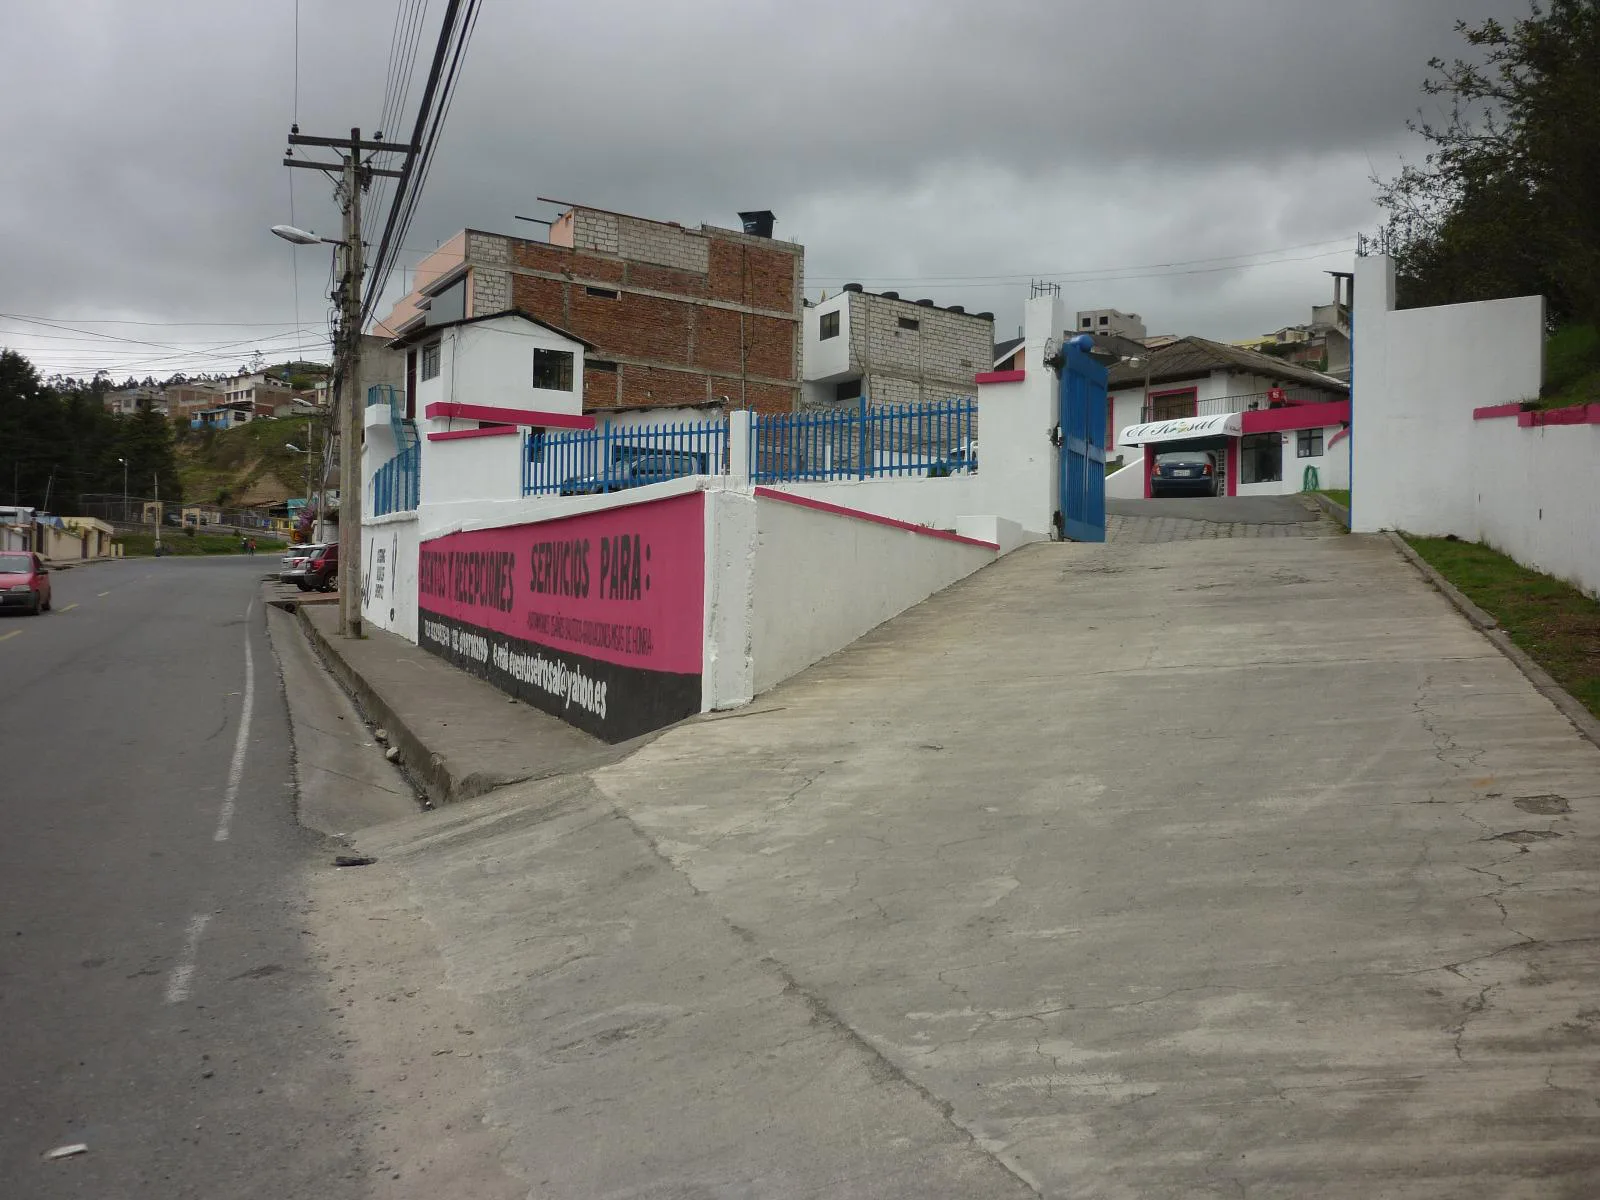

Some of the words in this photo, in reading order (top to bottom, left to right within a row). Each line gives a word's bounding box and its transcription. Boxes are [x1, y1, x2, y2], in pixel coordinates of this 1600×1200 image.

[530, 538, 590, 599] SERVICIOS
[600, 533, 652, 600] PARA:
[509, 650, 607, 719] eventoselrosal@yahoo.es
